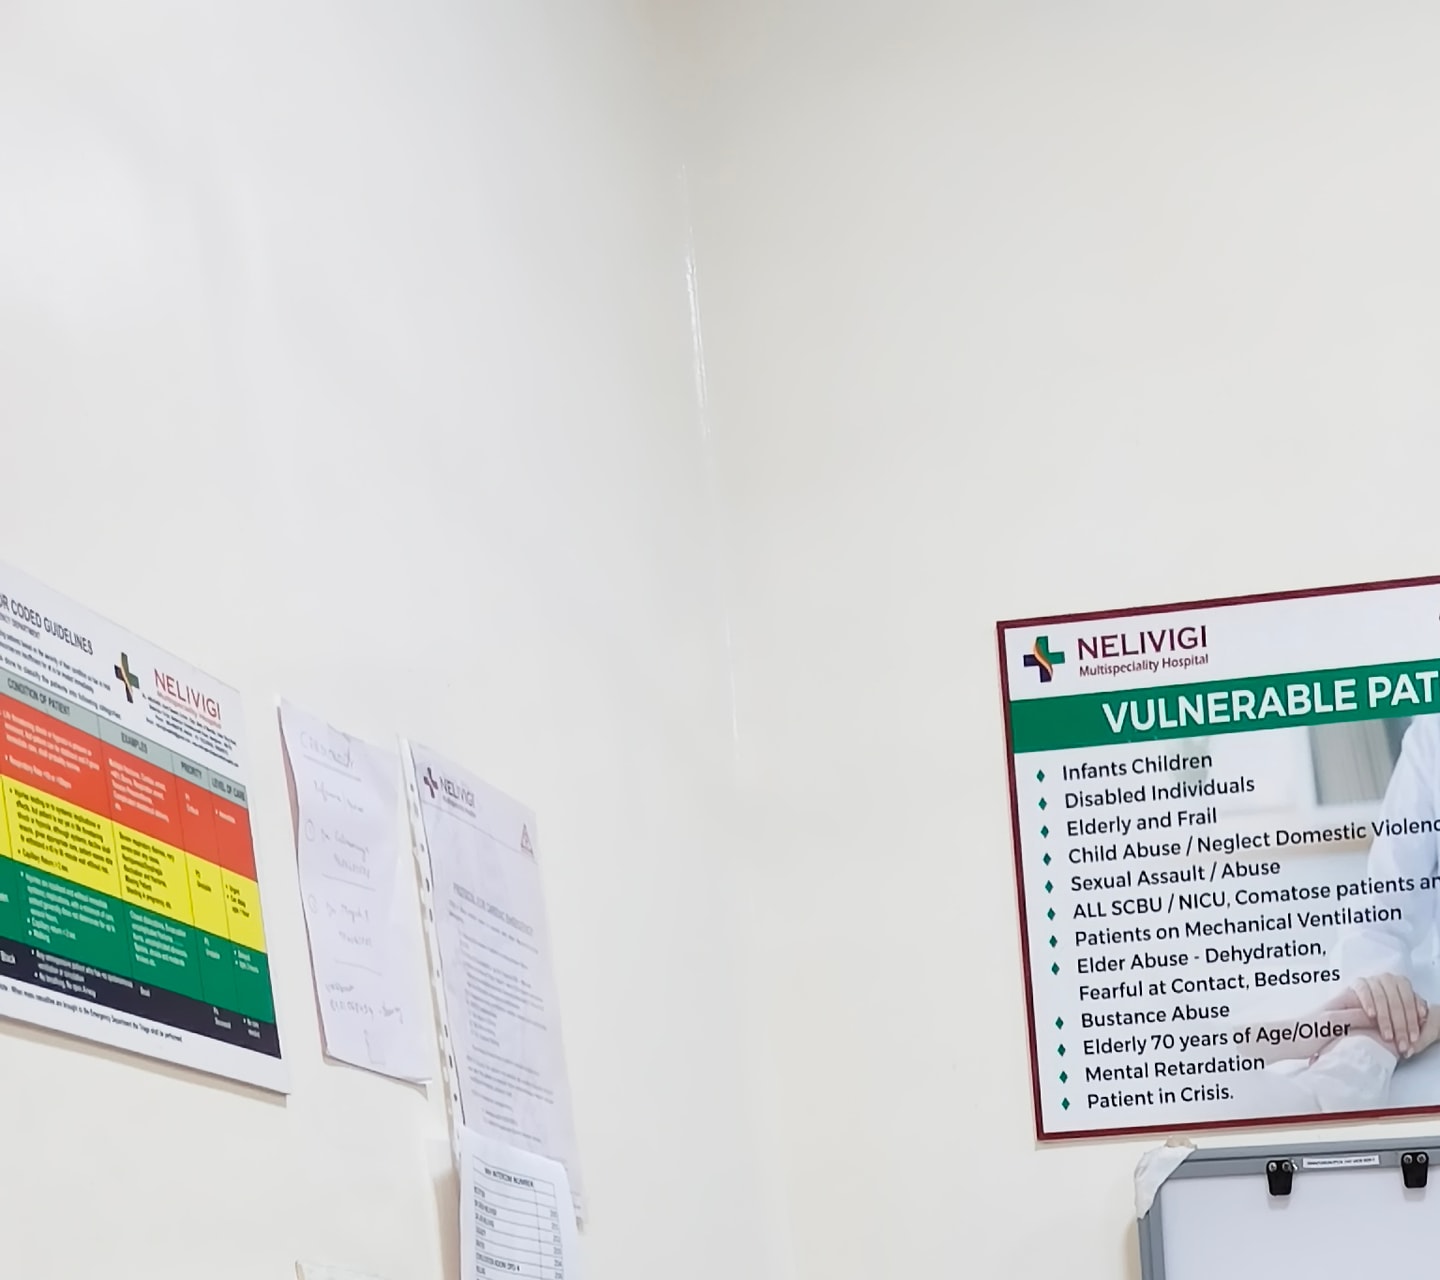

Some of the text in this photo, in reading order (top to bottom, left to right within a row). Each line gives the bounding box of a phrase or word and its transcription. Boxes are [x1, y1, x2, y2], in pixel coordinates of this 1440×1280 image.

[11, 599, 42, 628] CODED
[43, 616, 94, 655] GUIDELINES
[1077, 625, 1207, 661] NELIVIGI
[1079, 653, 1209, 677] Multispeciality Hospital
[154, 668, 221, 720] NELIVIGI
[1102, 678, 1358, 734] VULNERABLE
[1062, 753, 1213, 781] Infants Children
[1065, 775, 1255, 809] Disabled Individuals
[1066, 806, 1217, 837] Elderly and Frail
[1068, 844, 1117, 864] Child
[1122, 841, 1181, 860] Abuse
[1186, 835, 1193, 857] /
[1197, 832, 1271, 855] Neglect
[1276, 822, 1366, 846] Domestic
[1071, 861, 1281, 892] Sexual Assault / Abuse
[1073, 901, 1107, 919] ALL
[1111, 896, 1162, 916] SCBU
[1167, 893, 1175, 914] /
[1178, 891, 1231, 910] NICU,
[1235, 886, 1331, 905] Comatose
[1336, 877, 1415, 901] patients
[1075, 905, 1402, 947] Patients on Mechanical Ventilation
[1077, 955, 1126, 974] Elder
[1130, 952, 1189, 970] Abuse
[1205, 940, 1326, 965] Dehydration,
[1079, 968, 1341, 1001] Fearful at Contact, Bedsores
[1081, 1004, 1230, 1029] Bustance Abuse
[1083, 1021, 1351, 1056] Elderly 70 years of Age/Older
[1085, 1055, 1265, 1082] Mental Retardation
[1087, 1083, 1234, 1109] Patient in Crisis.
